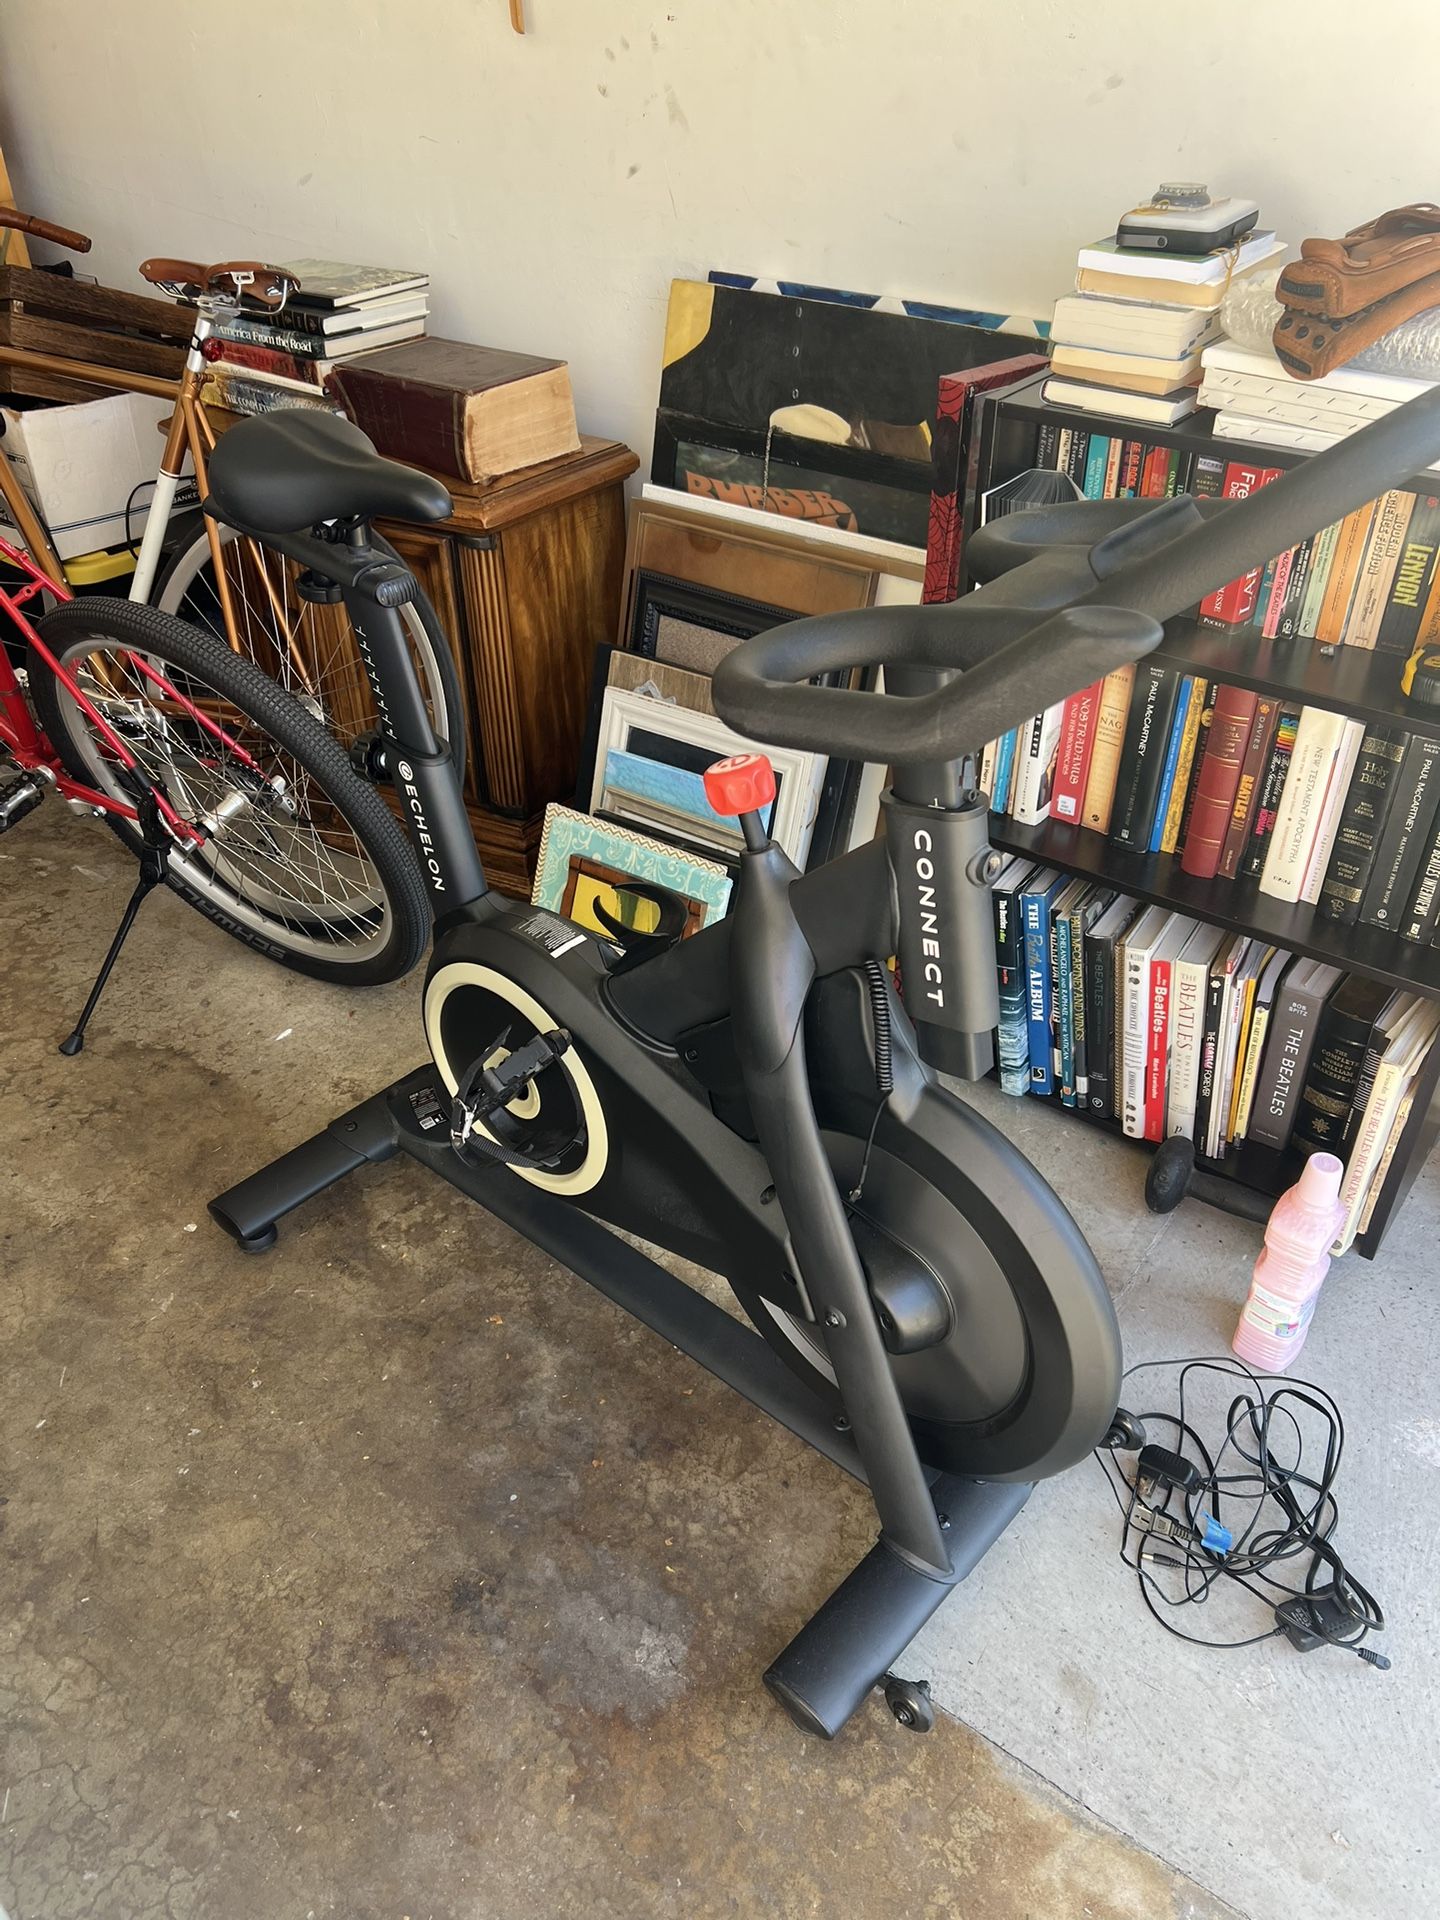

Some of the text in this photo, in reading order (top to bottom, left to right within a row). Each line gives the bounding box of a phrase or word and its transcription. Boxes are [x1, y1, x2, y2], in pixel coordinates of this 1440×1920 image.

[219, 325, 312, 353] America From the Road
[1077, 440, 1086, 459] There
[685, 470, 852, 518] RUBBER
[1368, 490, 1399, 576] SCIENCE FICTION
[1386, 513, 1407, 559] MODERN
[1275, 581, 1284, 591] THE
[1278, 570, 1286, 579] OF
[1392, 543, 1435, 608] LENNON
[1270, 592, 1282, 615] BEATLES
[1148, 680, 1159, 703] PAUL
[1100, 716, 1122, 730] NAG
[1138, 704, 1154, 757] McCARTNEY
[1252, 716, 1265, 750] DAVIES
[1030, 730, 1041, 756] LIFE
[1068, 696, 1093, 785] NOSTRADAMUS
[982, 768, 990, 784] Harry
[1360, 772, 1386, 789] Bible
[1364, 760, 1389, 778] Holy
[1234, 774, 1255, 820] BEATLES
[1262, 773, 1276, 807] Generation
[1288, 747, 1325, 864] NEW TESTAMENT APOCRYPHA
[405, 784, 446, 891] ECHELON
[1256, 808, 1269, 836] NORMAN
[1382, 758, 1433, 905] PAUL McCARTNEY MANY YEARS FROM NOW
[1425, 848, 1440, 879] BEATLES
[998, 900, 1008, 909] The
[1414, 878, 1438, 917] INTERVIEWS
[168, 872, 286, 960] SCHWALB
[914, 830, 944, 1008] CONNECT
[998, 909, 1008, 929] Beatles
[1026, 904, 1044, 1023] THE Beatles ALBUM
[1059, 924, 1068, 975] MICHELANGELO
[1070, 916, 1085, 1040] PAUL McCARTNEY AND WINGS
[1094, 964, 1104, 1006] BEATLES
[1182, 974, 1197, 982] THE
[1061, 987, 1069, 1018] RAPHAEL
[1152, 986, 1168, 1033] Beatles
[1288, 1006, 1308, 1017] SPITZ
[1292, 1002, 1307, 1011] BOB
[1062, 1032, 1070, 1061] VATICAN
[1176, 982, 1198, 1089] BEATLES UNSEEN
[1334, 1048, 1348, 1057] THE
[1174, 1053, 1183, 1097] ARCHIVES
[1202, 1031, 1216, 1097] THE BEATLES FOREVER
[1270, 1028, 1304, 1116] THE BEATLES
[1322, 1049, 1359, 1067] COMPLETE
[1322, 1060, 1354, 1078] WILLIAM
[1325, 1057, 1344, 1068] WORKS
[1362, 1048, 1382, 1076] John
[1351, 1074, 1377, 1113] Lennon
[1374, 1098, 1387, 1116] THE
[1363, 1116, 1382, 1153] BEATLES
[1346, 1152, 1369, 1203] RECORDING
